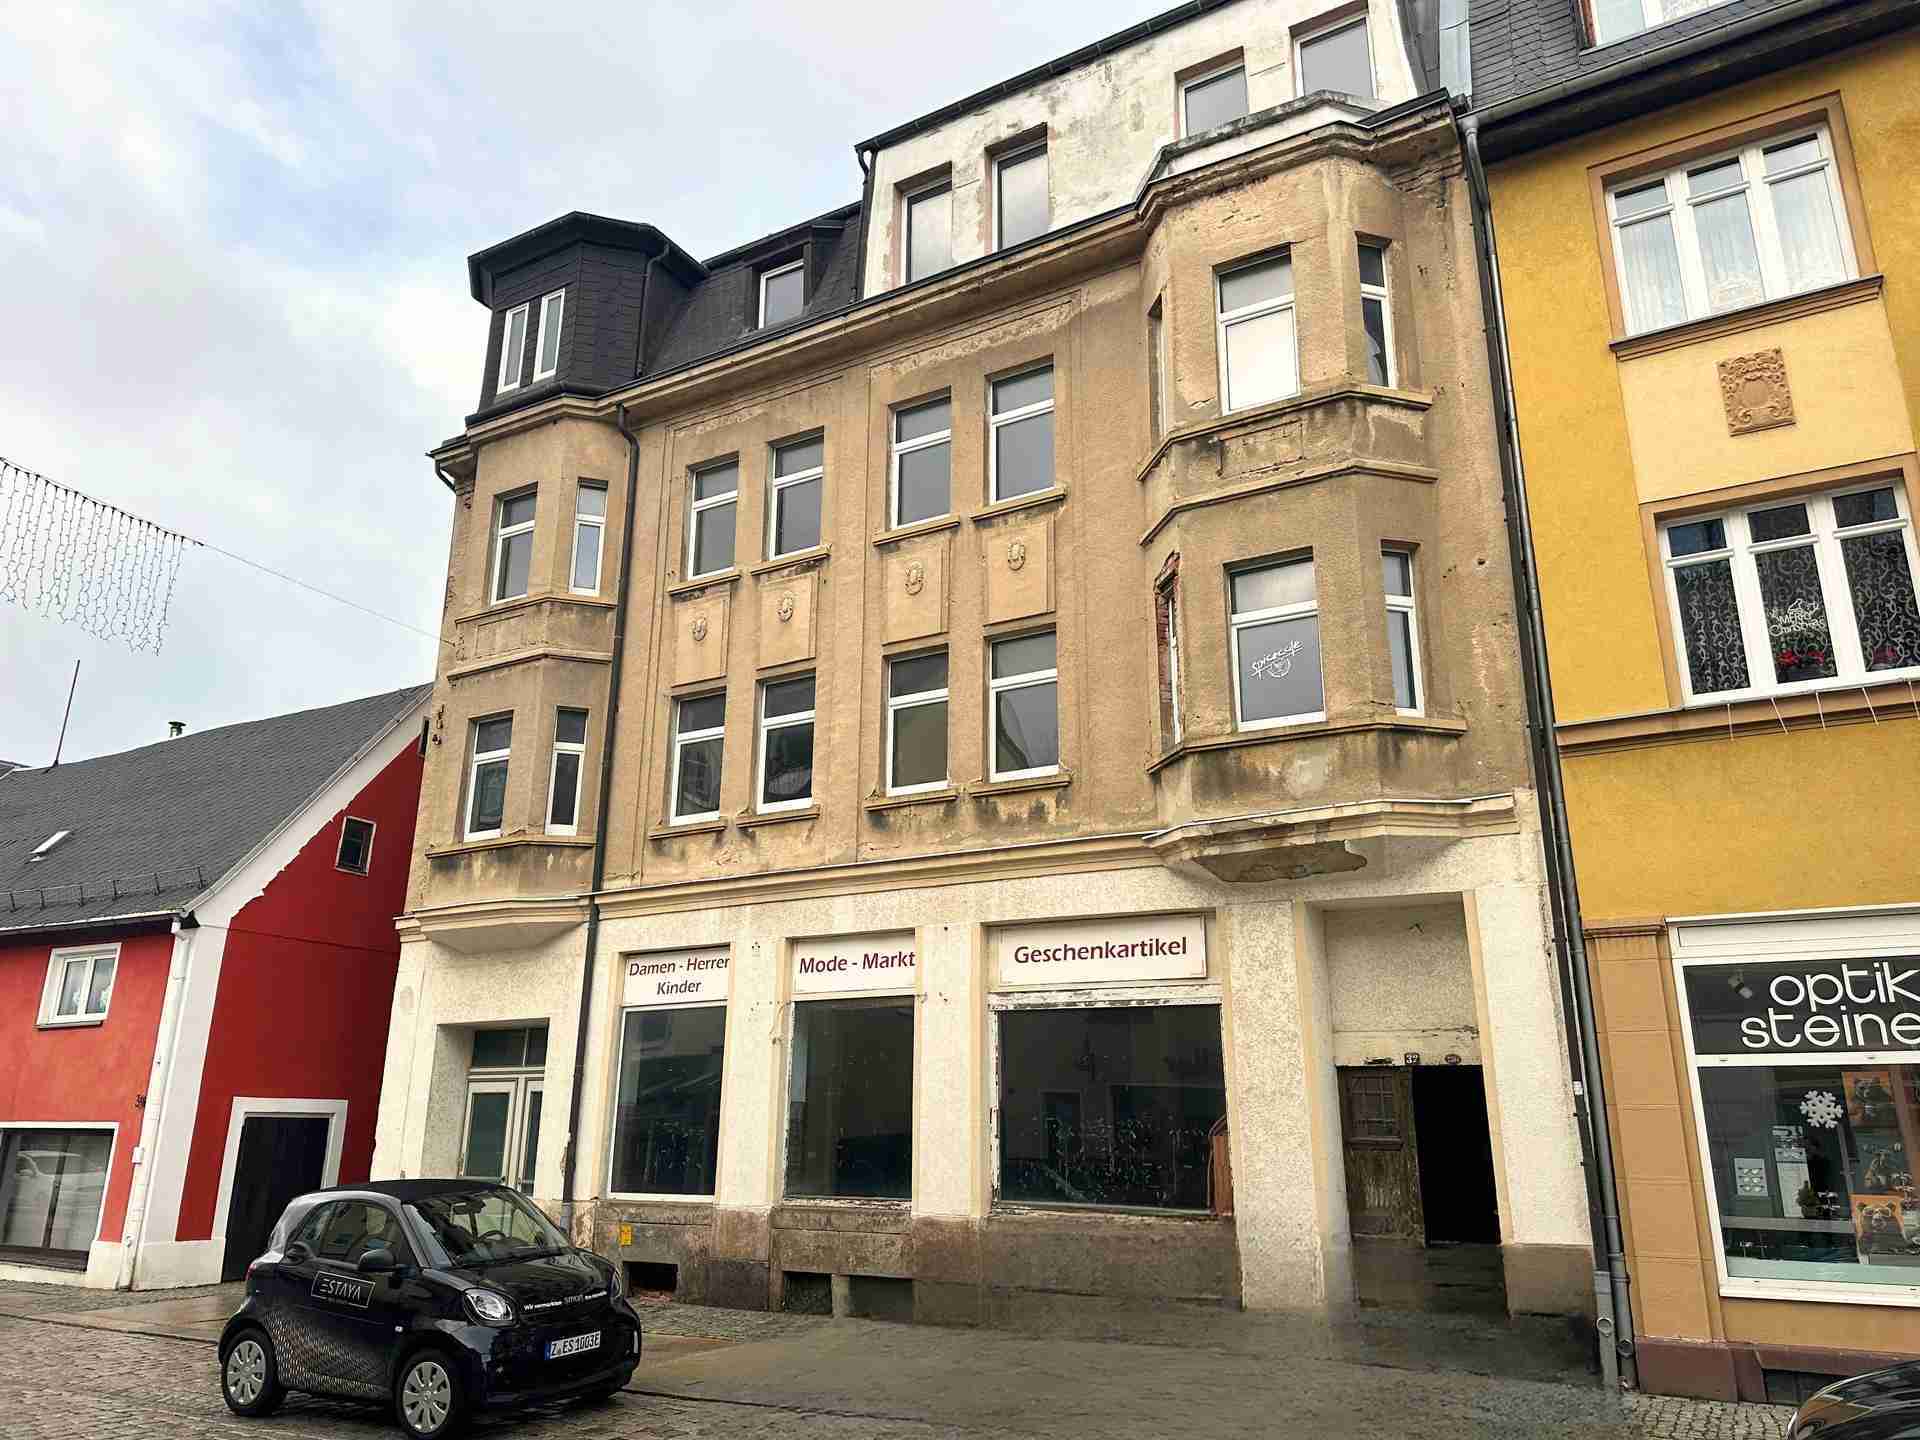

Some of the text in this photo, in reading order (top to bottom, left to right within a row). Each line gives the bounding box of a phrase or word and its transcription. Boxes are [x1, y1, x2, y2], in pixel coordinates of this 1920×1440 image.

[1014, 936, 1188, 963] Geschenkartikel
[629, 962, 676, 976] Damen
[800, 955, 848, 974] Mode
[862, 951, 916, 969] Markt
[657, 980, 701, 995] Kinder
[1769, 961, 1920, 1012] optik
